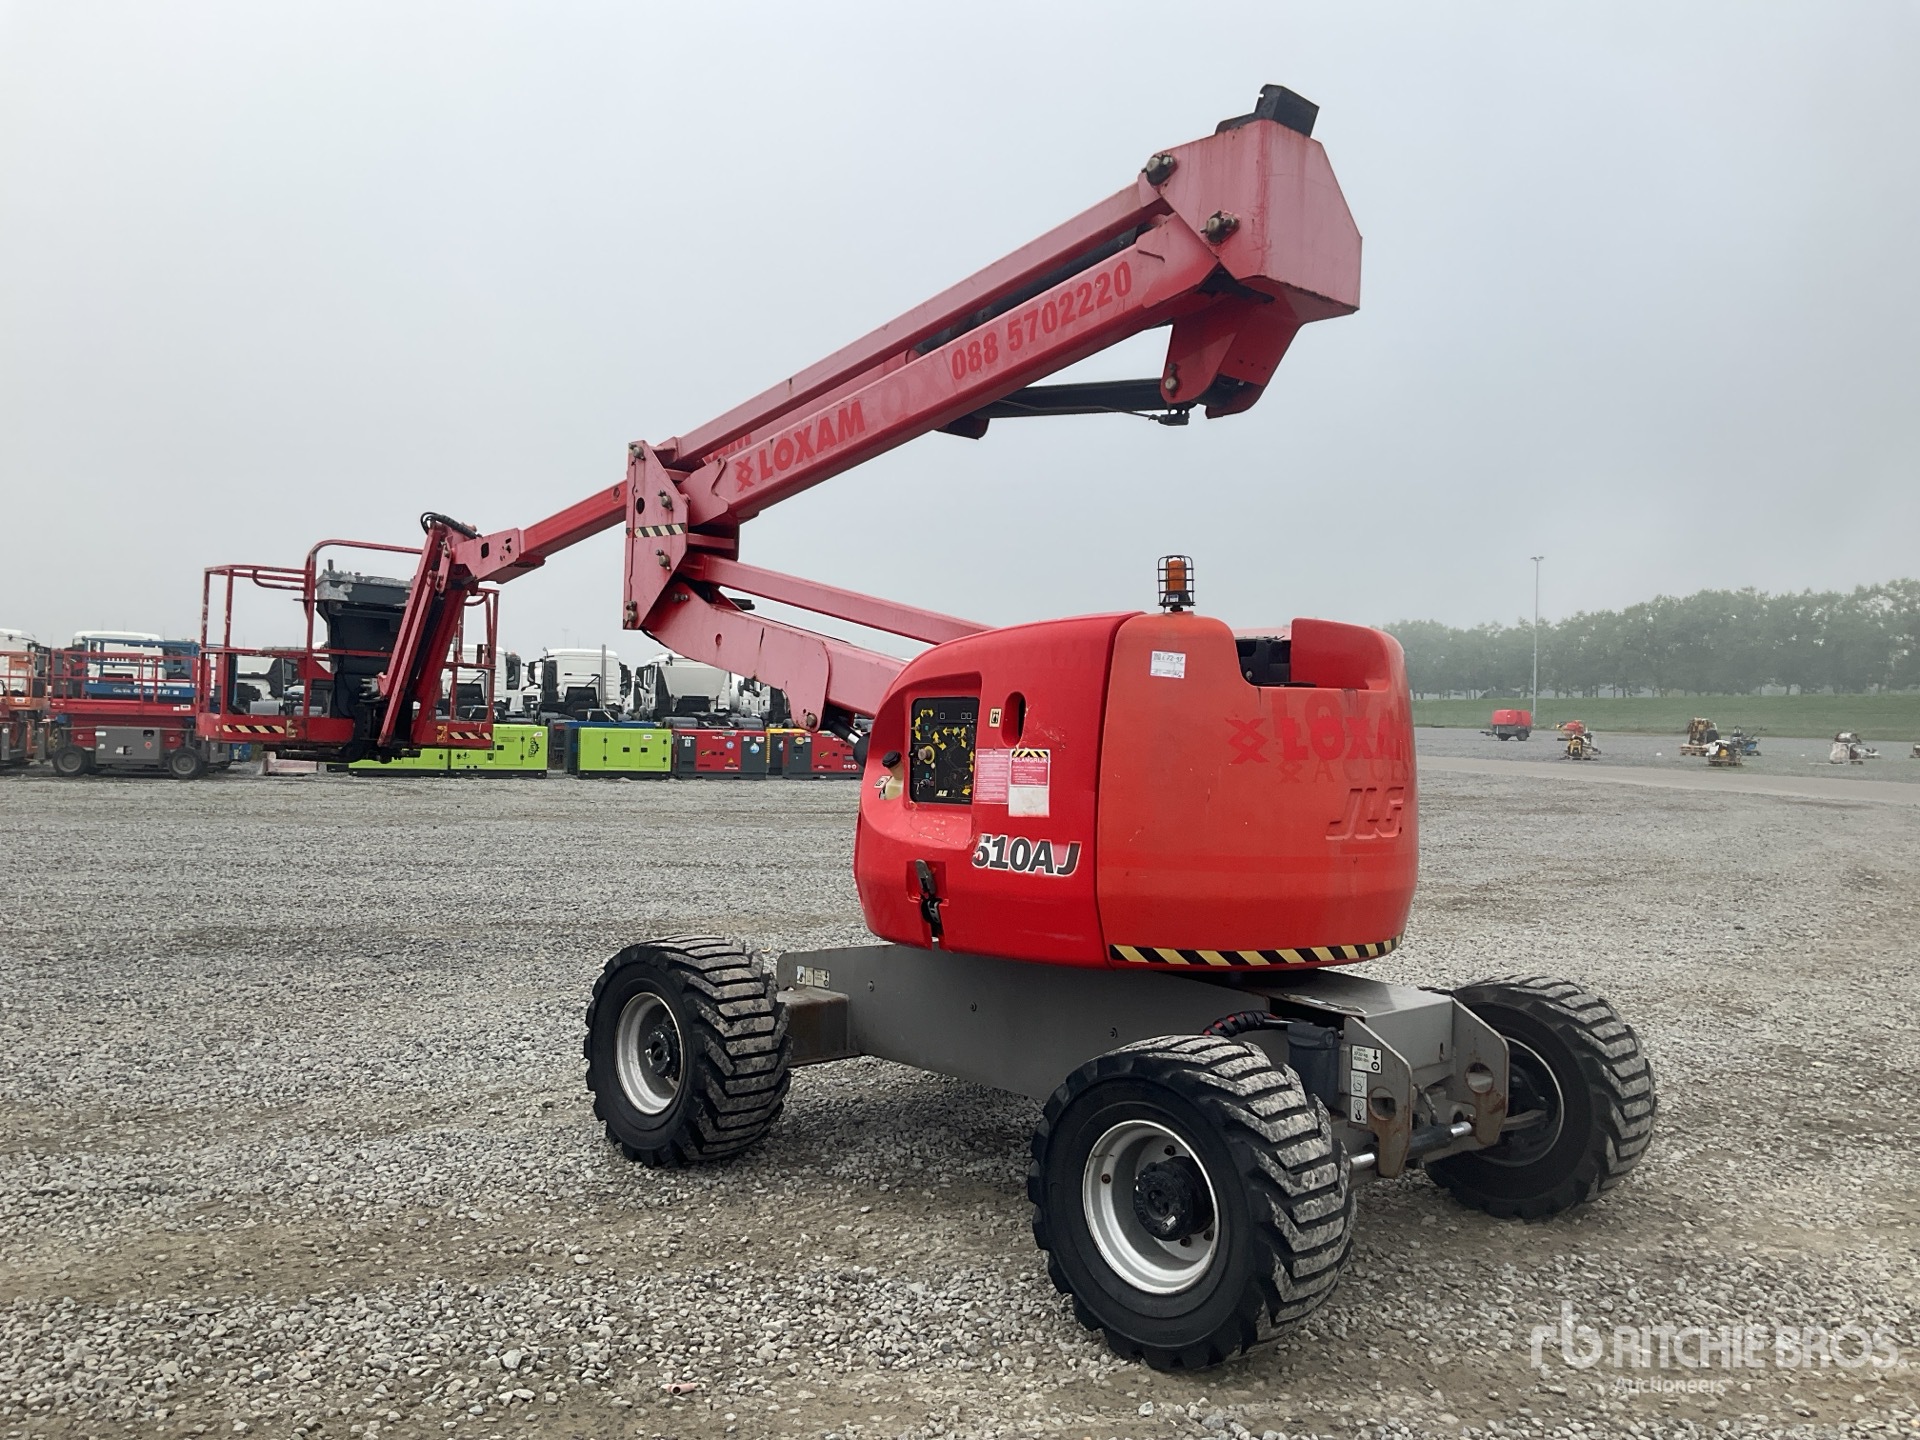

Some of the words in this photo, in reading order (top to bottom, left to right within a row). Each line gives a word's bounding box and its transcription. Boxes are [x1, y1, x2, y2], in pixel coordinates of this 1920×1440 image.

[952, 331, 999, 380] 088
[1007, 261, 1133, 352] 5702220
[758, 400, 866, 481] LOXAM
[1324, 786, 1405, 841] JLG
[972, 833, 1082, 877] 510AJ
